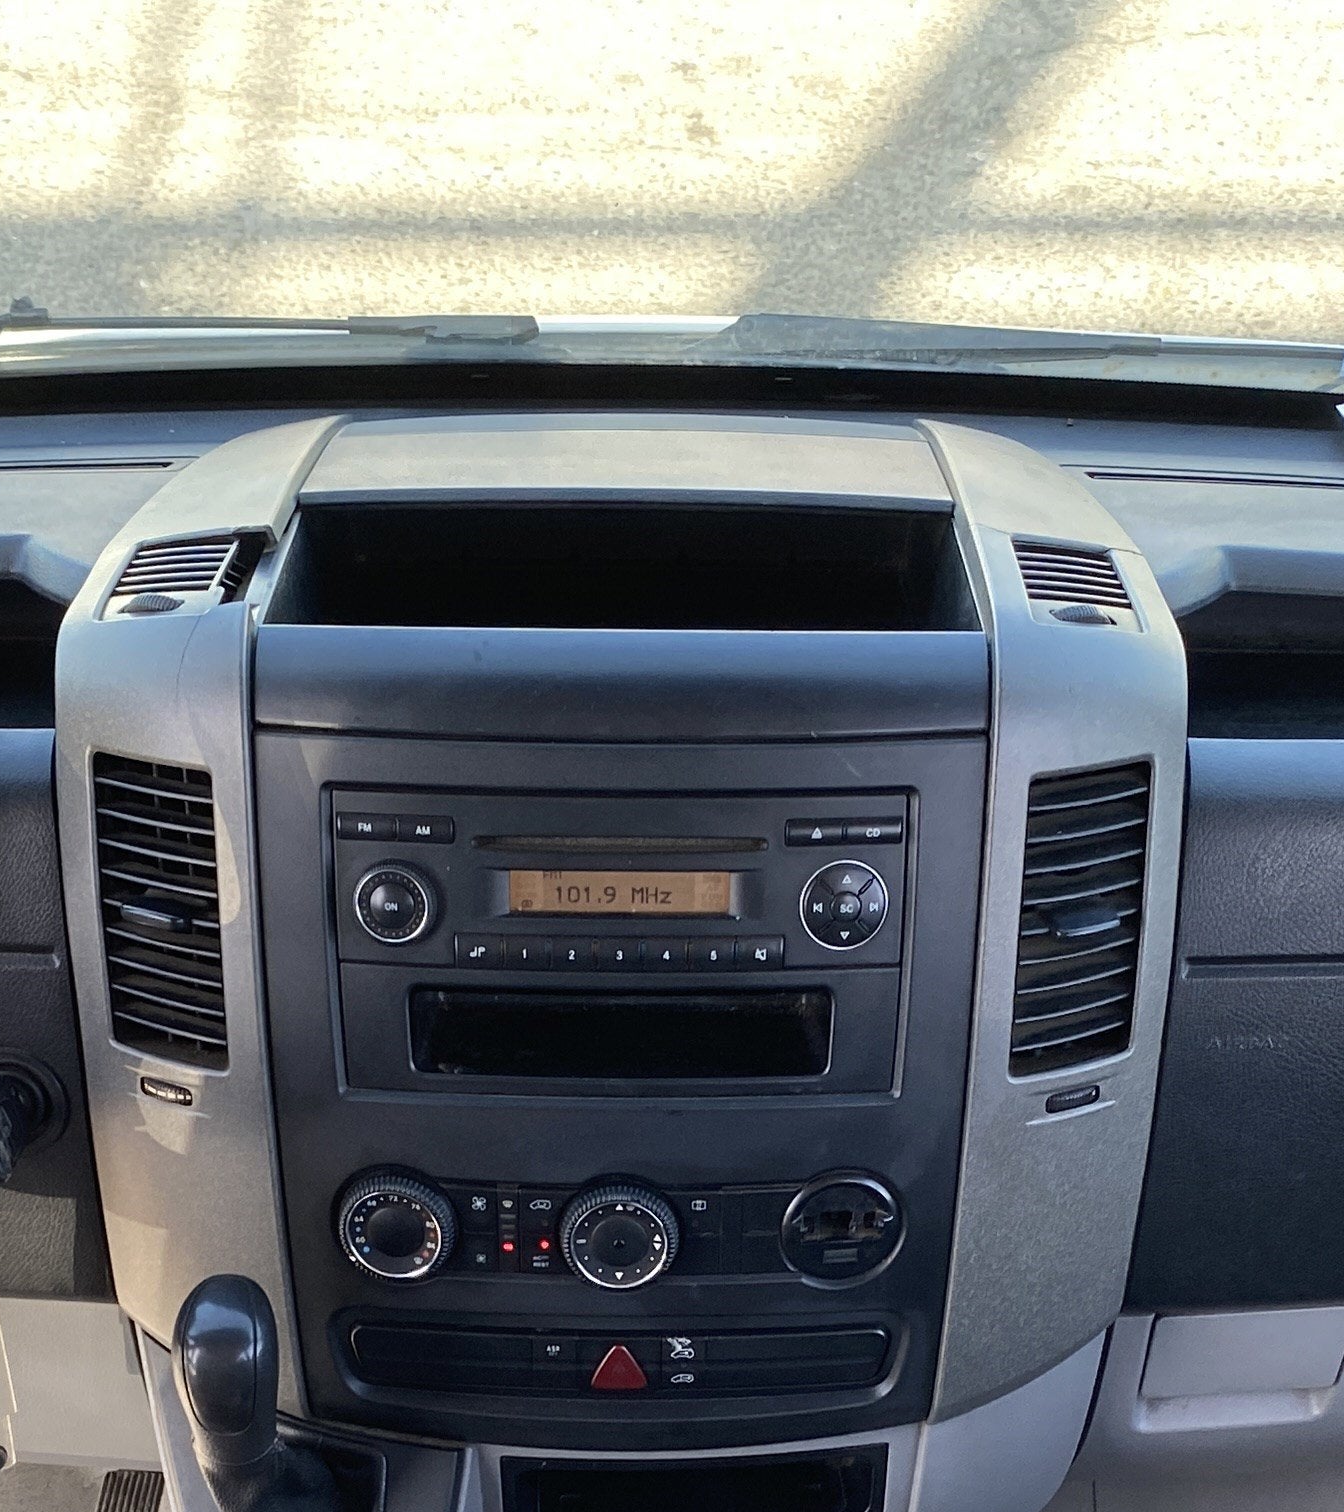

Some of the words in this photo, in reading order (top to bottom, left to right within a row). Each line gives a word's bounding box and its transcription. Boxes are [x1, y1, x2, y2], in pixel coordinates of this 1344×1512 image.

[357, 822, 372, 833] FM
[415, 825, 431, 836] AM
[865, 827, 881, 838] CD
[555, 885, 617, 905] 101.9
[631, 886, 673, 906] MHz
[384, 901, 399, 912] ON
[839, 902, 855, 914] SC
[521, 948, 528, 960] 1
[567, 949, 576, 961] 2
[615, 950, 624, 961] 3
[662, 950, 671, 961] 4
[709, 950, 718, 961] 5
